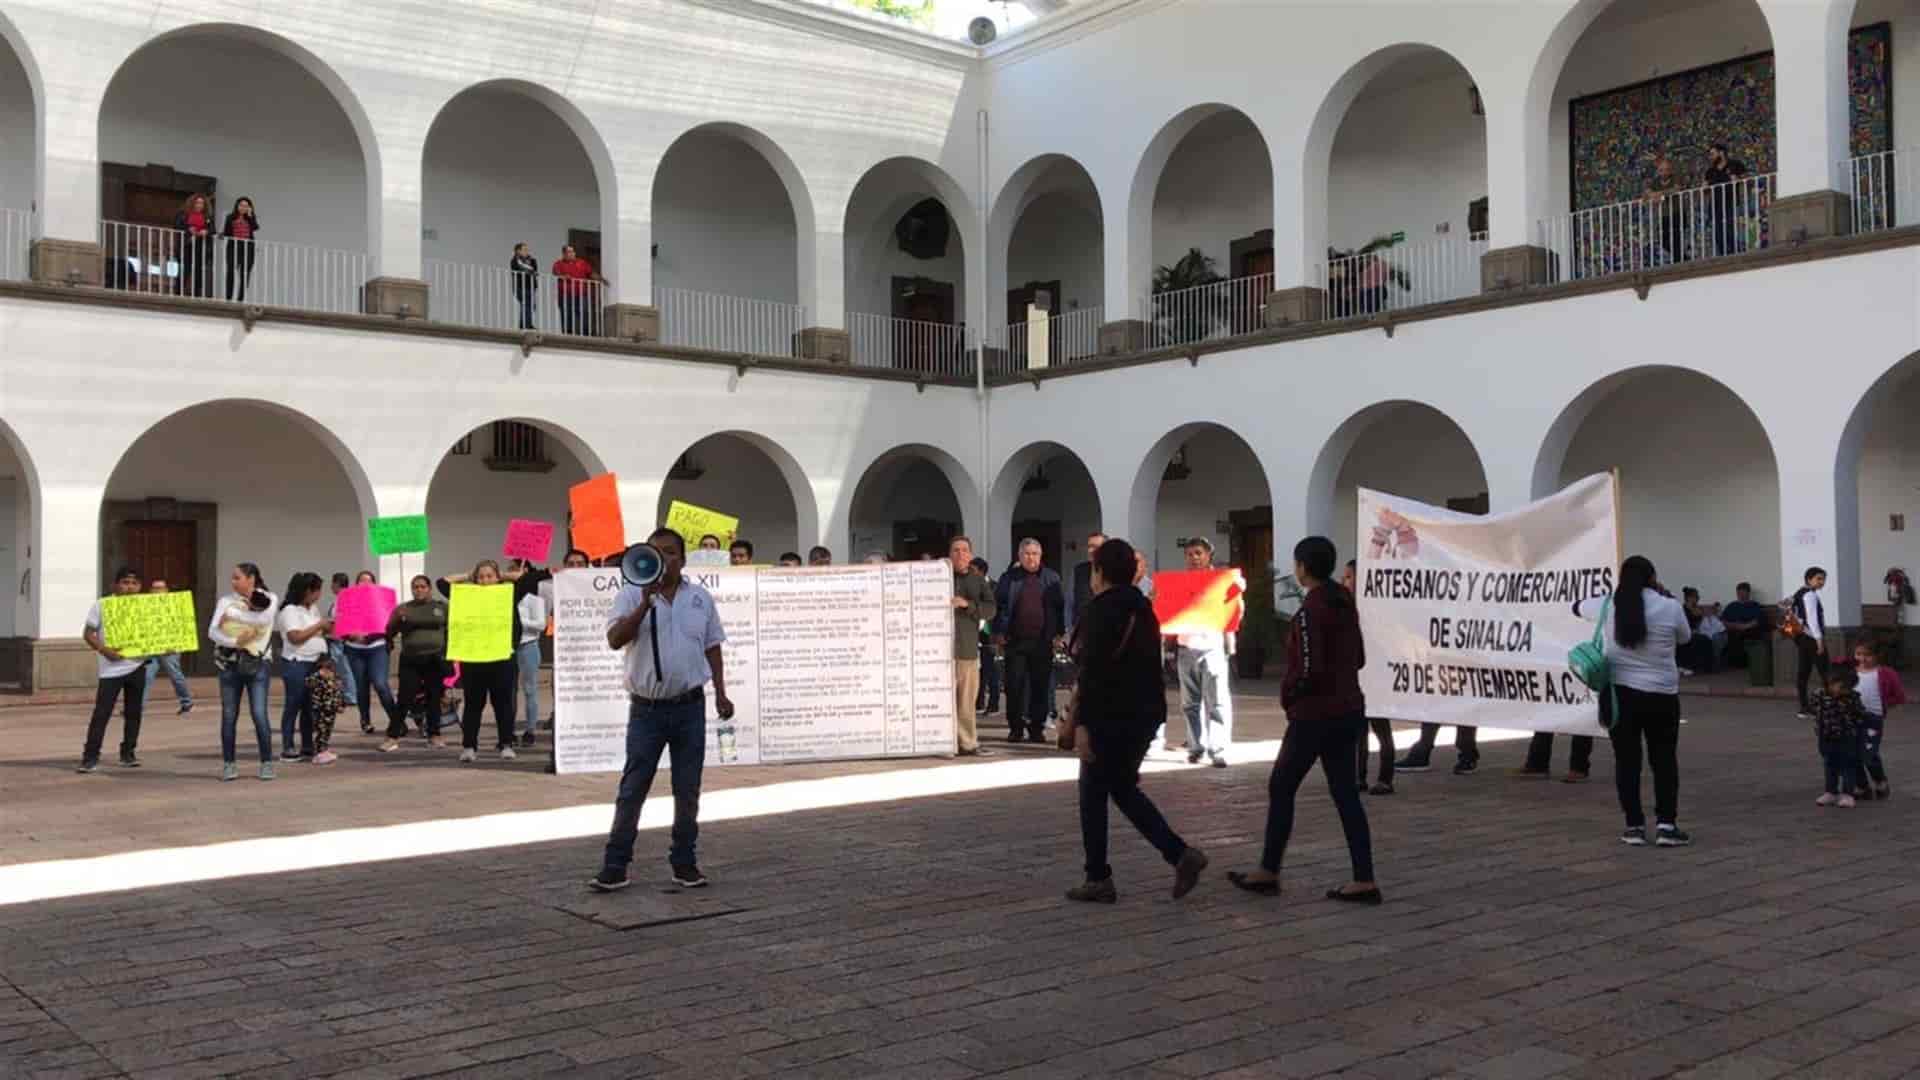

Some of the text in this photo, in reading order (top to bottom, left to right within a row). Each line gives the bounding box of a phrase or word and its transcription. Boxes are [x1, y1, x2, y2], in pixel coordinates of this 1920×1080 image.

[698, 573, 720, 589] XII
[1364, 567, 1613, 604] ARTESANOS Y COMERCIANTES
[1430, 617, 1532, 652] DE SINALOA
[1414, 662, 1434, 694] DE
[1438, 664, 1541, 702] SEPTIEMBRE
